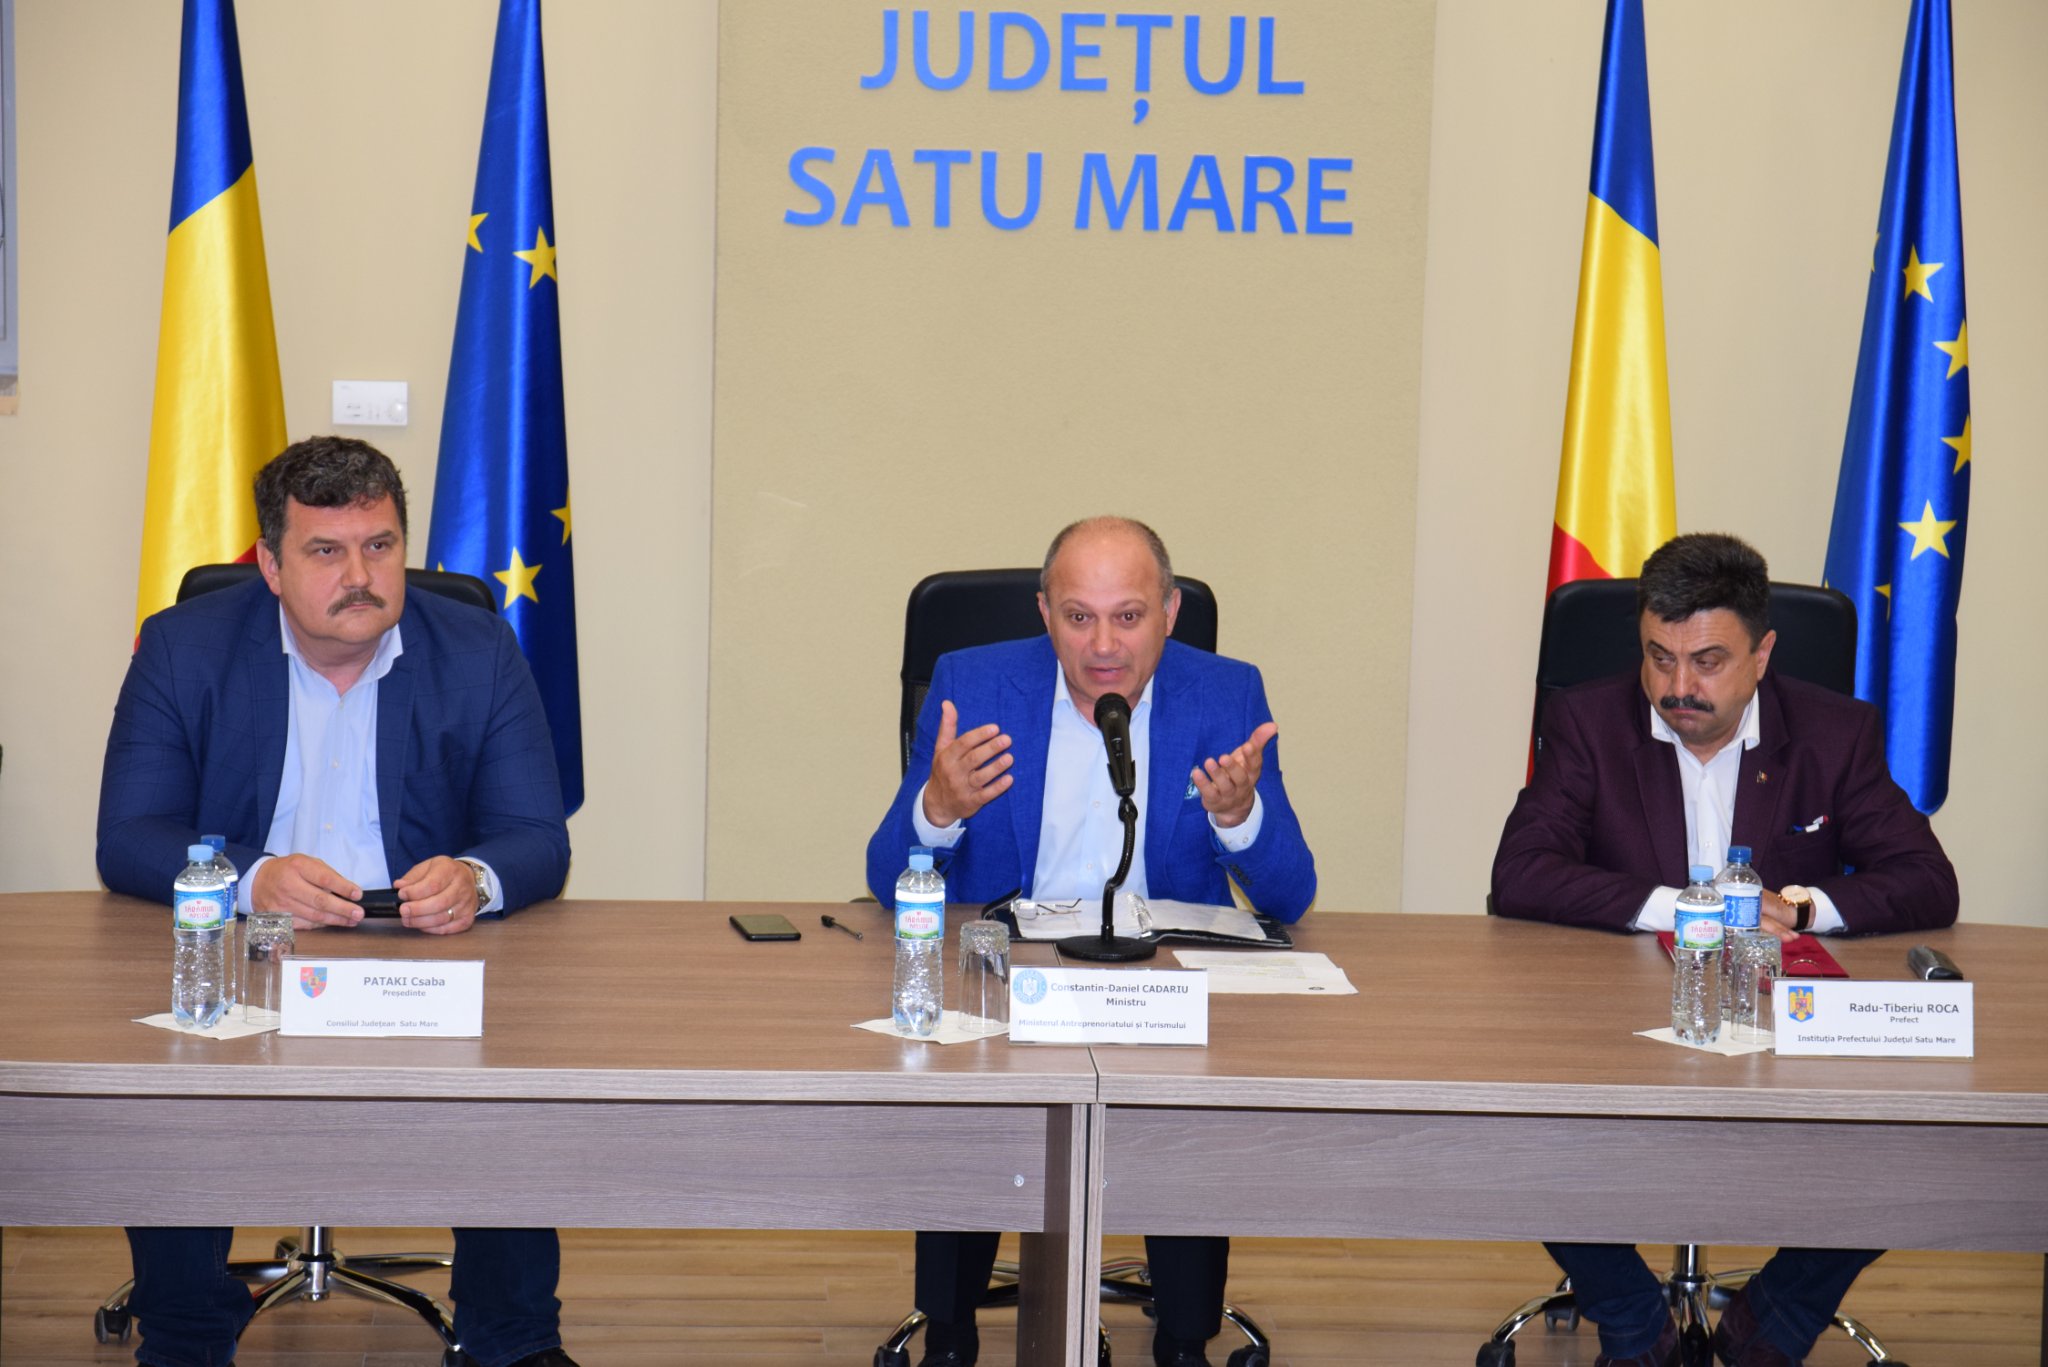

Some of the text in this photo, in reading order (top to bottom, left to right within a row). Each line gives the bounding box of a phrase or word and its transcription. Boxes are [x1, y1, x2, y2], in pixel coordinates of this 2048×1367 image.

[860, 9, 1305, 125] JUDEȚUL
[784, 146, 1353, 235] SATU MARE
[363, 976, 446, 987] PATAKI Csaba
[1050, 982, 1189, 994] Constantin-Daniel CADARIU
[1106, 997, 1146, 1007] Ministru
[1849, 1003, 1960, 1014] Radu-Tiberiu ROCA
[1018, 1018, 1059, 1027] Ministerul
[1060, 1019, 1134, 1029] Antreprenoriatului
[1144, 1021, 1186, 1029] Turismului
[1890, 1016, 1919, 1024] Prefect
[1837, 1035, 1881, 1043] Prefectului
[1915, 1036, 1934, 1044] Satu
[1936, 1036, 1956, 1044] Mare
